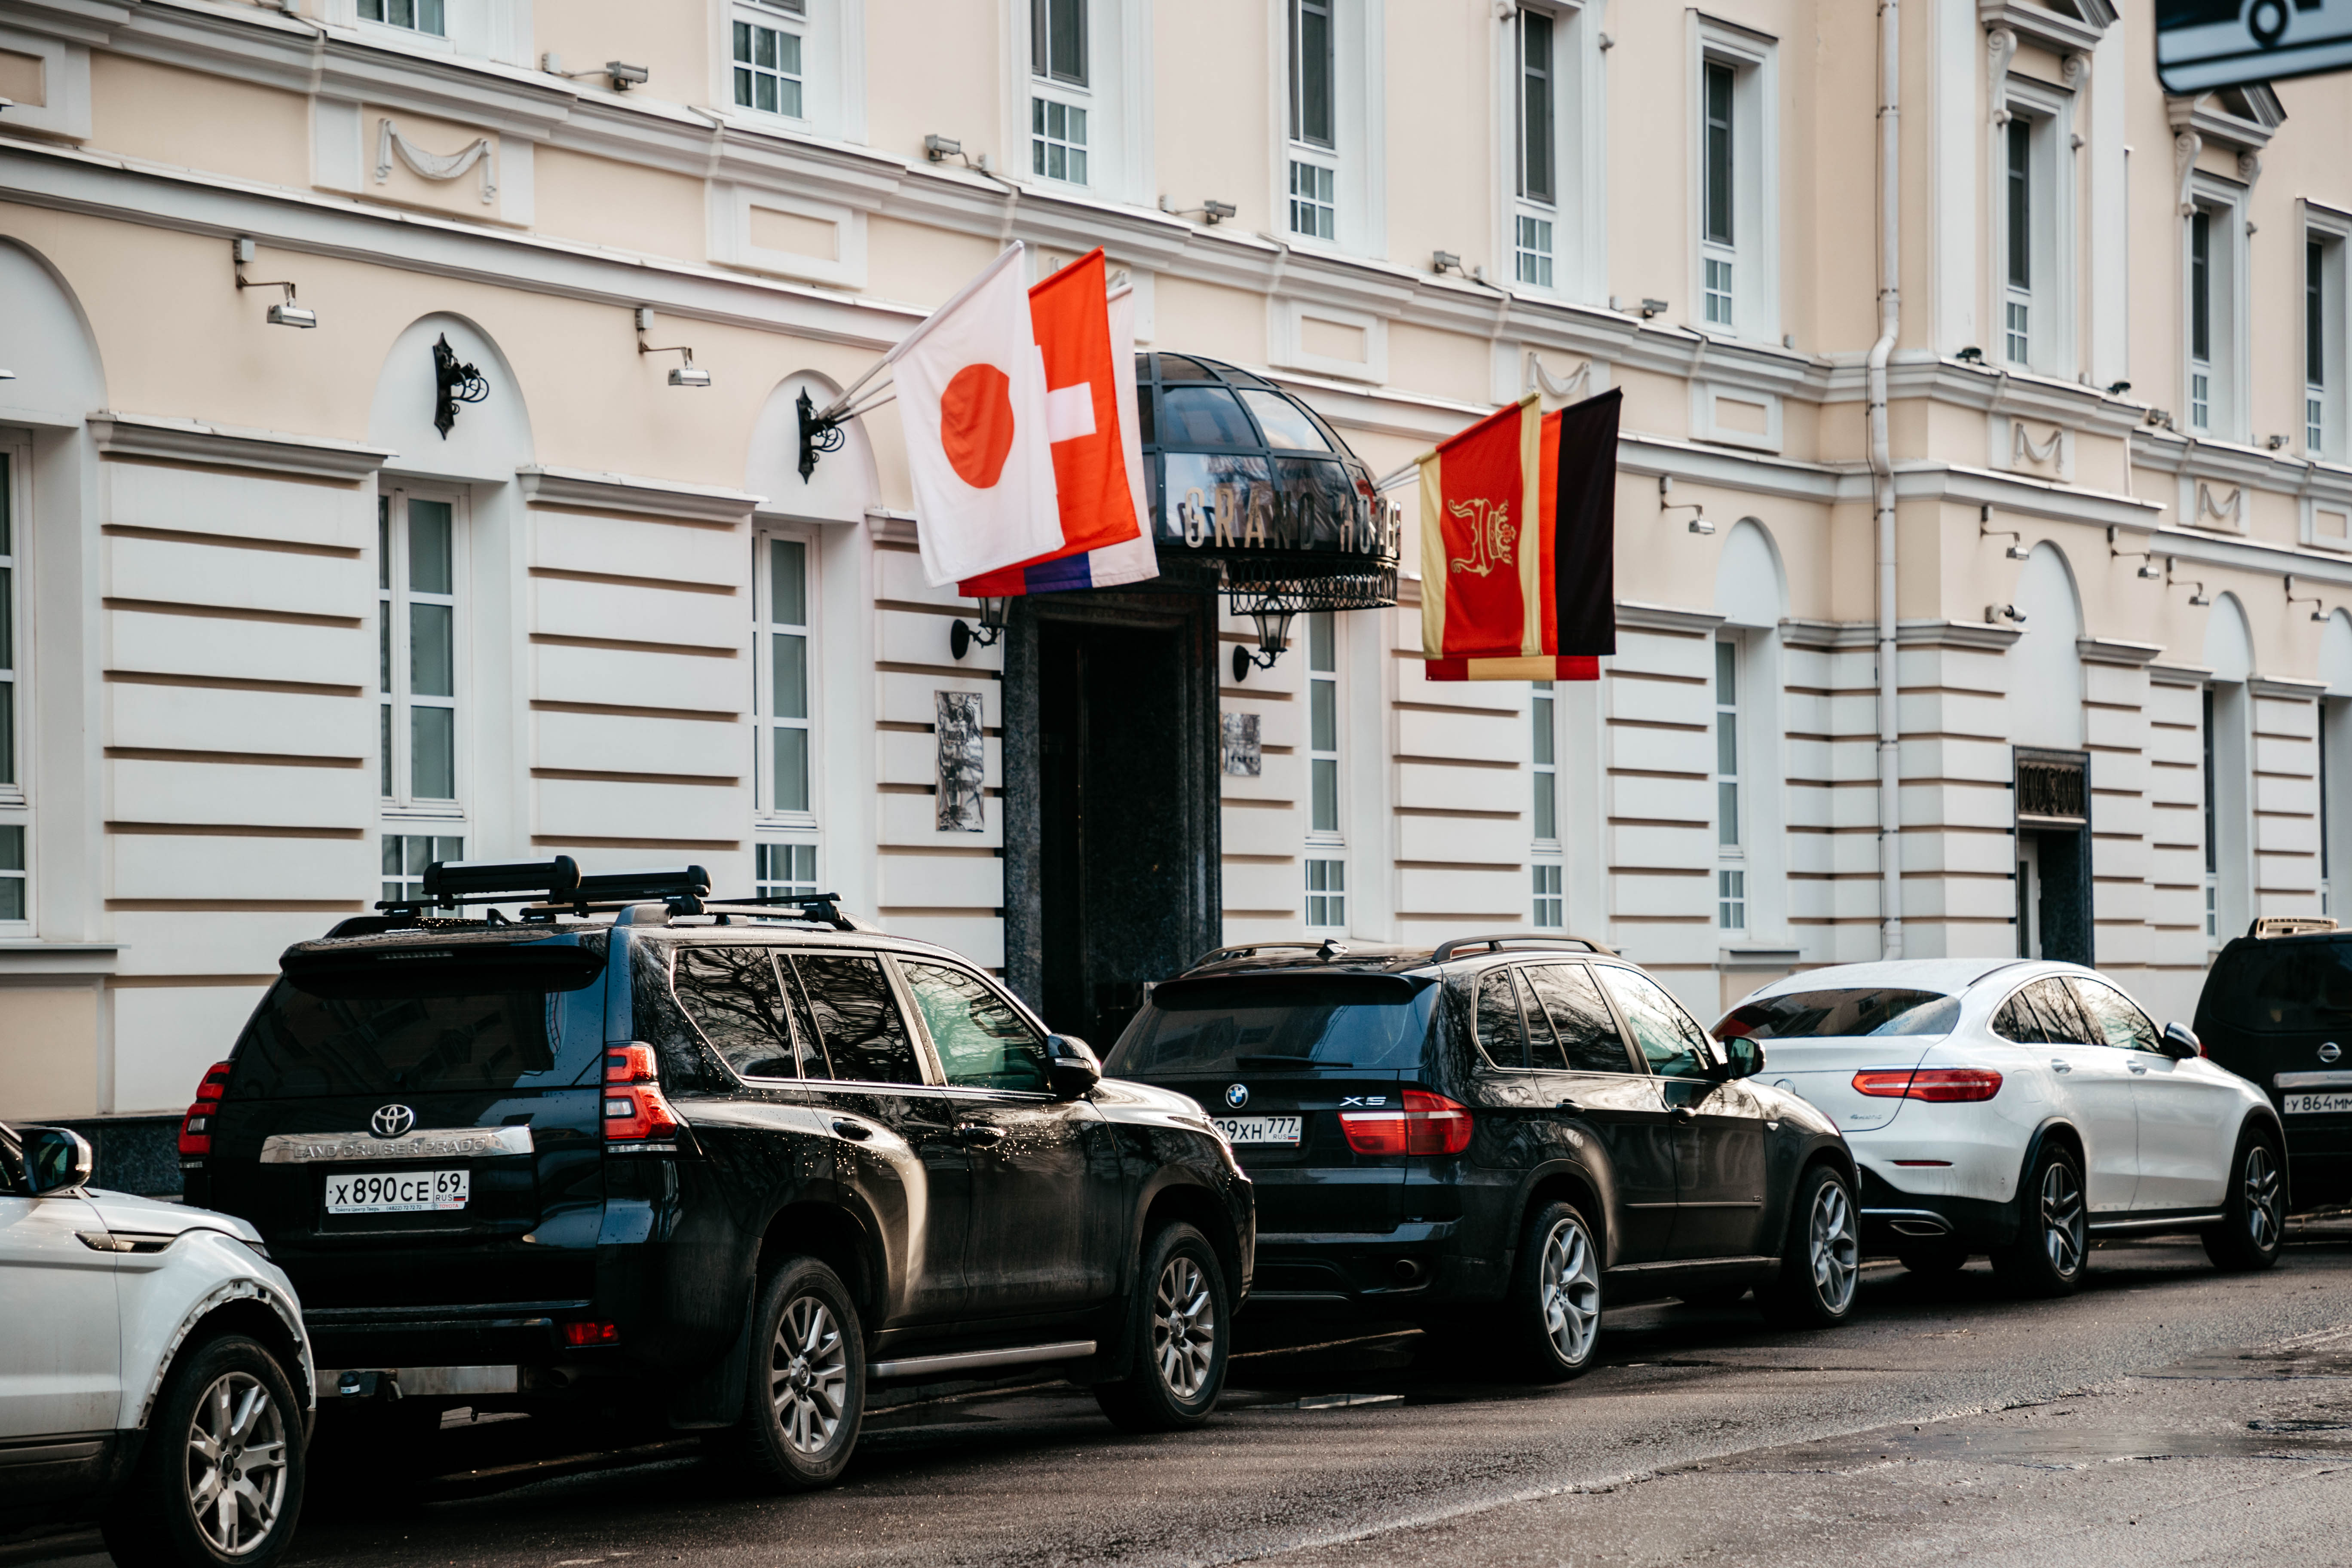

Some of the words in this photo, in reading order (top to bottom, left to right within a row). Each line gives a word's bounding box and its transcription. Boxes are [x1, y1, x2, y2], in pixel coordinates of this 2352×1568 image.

[1185, 486, 1315, 551] GRAND
[1338, 1096, 1387, 1106] X5
[1268, 1118, 1296, 1134] 777
[294, 1145, 337, 1158] LAND
[343, 1142, 419, 1157] CRUISER
[423, 1139, 486, 1153] PRADO
[437, 1173, 461, 1193] 69
